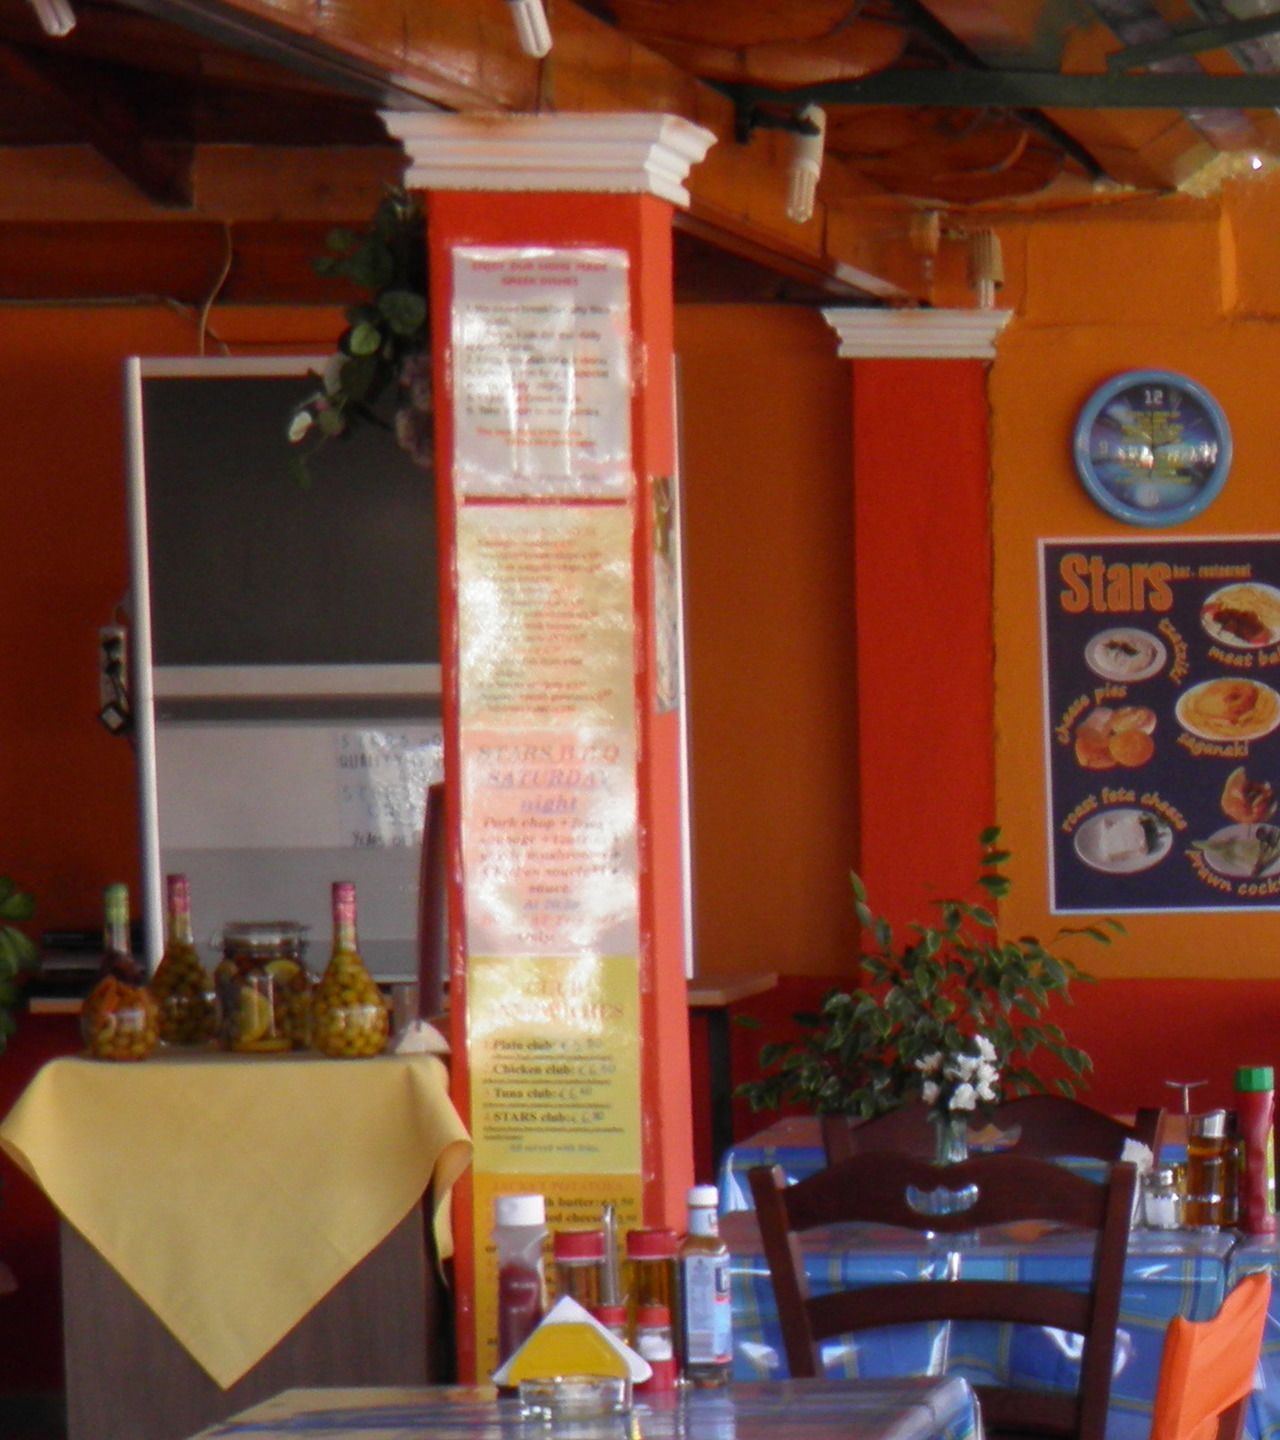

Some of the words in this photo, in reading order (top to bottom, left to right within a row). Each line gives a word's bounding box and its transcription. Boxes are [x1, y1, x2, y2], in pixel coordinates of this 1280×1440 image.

[1145, 390, 1163, 404] 12
[1060, 553, 1173, 613] Stars
[1207, 645, 1253, 670] meat
[1094, 682, 1128, 705] pies
[520, 795, 578, 815] night
[493, 1063, 542, 1075] Chicken
[494, 1087, 524, 1098] Tuna
[493, 1112, 537, 1122] STARS
